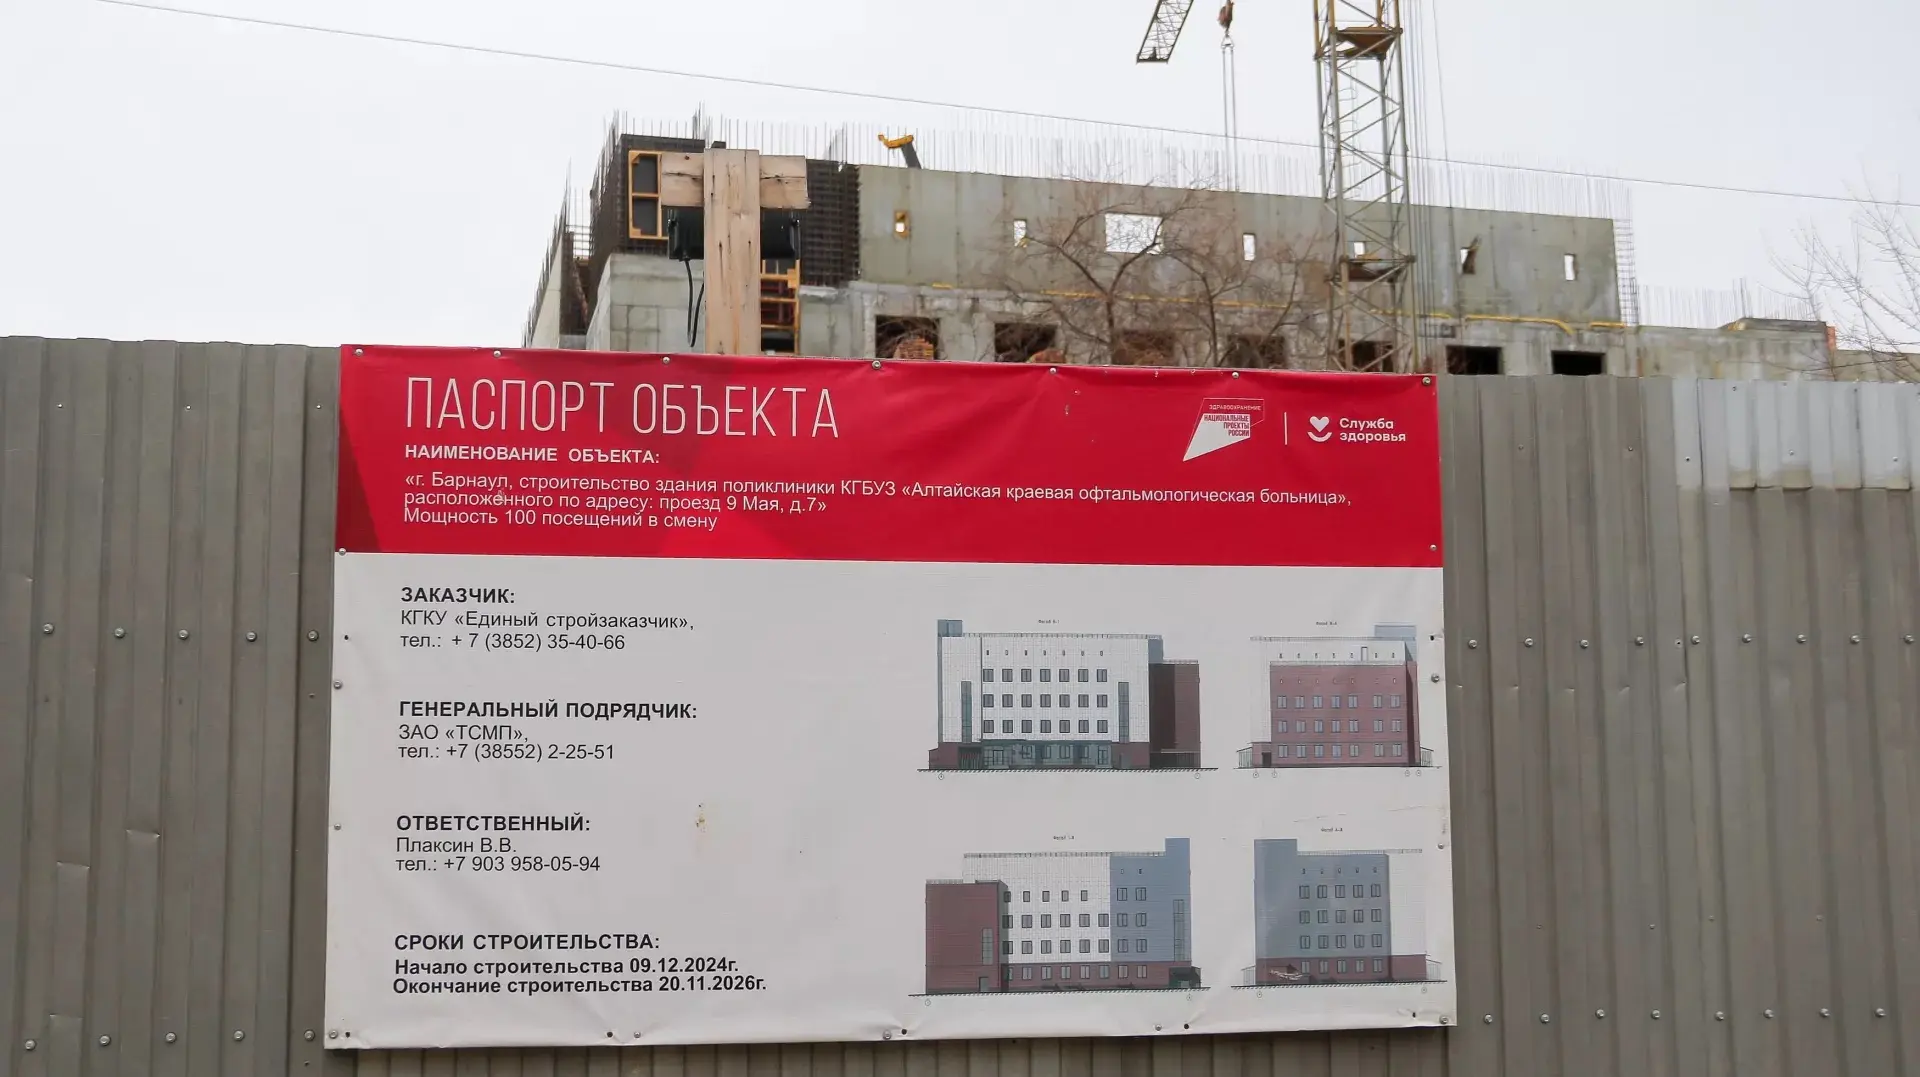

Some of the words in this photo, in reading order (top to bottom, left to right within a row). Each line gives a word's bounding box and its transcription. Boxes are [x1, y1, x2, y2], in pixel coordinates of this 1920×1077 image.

[407, 377, 614, 432] ПАСПОРТ
[633, 384, 838, 437] ОБЪЕКТА
[1204, 414, 1249, 422] НАЦИОНАЛЬНЫЕ
[1340, 418, 1393, 431] Служба
[1340, 433, 1405, 443] здоровья
[406, 445, 557, 461] НАИМЕНОВАНИЕ
[569, 449, 659, 463] ОБЪЕКТА:
[406, 475, 424, 486] «г.
[432, 472, 512, 491] Барнаул,
[520, 477, 649, 492] строительство
[656, 480, 716, 493] здания
[724, 481, 834, 494] поликлиники
[842, 480, 895, 495] КГБУЗ
[902, 482, 1000, 497] «Алтайская
[1007, 488, 1073, 501] краевая
[1079, 486, 1254, 503] офтальмологическая
[1260, 489, 1350, 506] больница»,
[404, 491, 553, 508] расположенного
[560, 496, 579, 507] по
[586, 496, 652, 512] адресу:
[660, 498, 720, 512] проезд
[727, 496, 736, 510] 9
[744, 496, 783, 513] Мая,
[790, 497, 826, 514] д.7»
[404, 507, 498, 525] Мощность
[506, 509, 535, 524] 100
[542, 511, 642, 528] посещений
[649, 516, 657, 526] в
[664, 516, 717, 531] смену
[401, 587, 514, 603] ЗАКАЗЧИК:
[402, 610, 447, 625] КГКУ
[455, 611, 537, 628] «Единый
[547, 613, 693, 630] стройзаказчик»,
[400, 636, 441, 647] тел.:
[452, 635, 461, 645] +
[469, 633, 478, 647] 7
[486, 633, 541, 652] (3852)
[548, 634, 624, 649] 35-40-66
[400, 699, 557, 717] ГЕНЕРАЛЬНЫЙ
[567, 703, 696, 721] ПОДРЯДЧИК:
[399, 724, 438, 739] ЗАО
[446, 725, 527, 742] «ТСМП»,
[398, 747, 439, 758] тел.:
[447, 744, 468, 758] +7
[475, 744, 542, 762] (38552)
[548, 744, 612, 759] 2-25-51
[397, 812, 589, 831] ОТВЕТСТВЕННЫЙ:
[397, 837, 473, 852] Плаксин
[481, 838, 516, 852] В.В.
[396, 860, 436, 871] тел.:
[444, 856, 465, 871] +7
[472, 856, 504, 871] 903
[511, 856, 600, 871] 958-05-94
[395, 935, 463, 950] СРОКИ
[474, 934, 659, 949] СТРОИТЕЛЬСТВА:
[396, 960, 467, 974] Начало
[474, 962, 623, 977] строительства
[630, 957, 738, 973] 09.12.2024г.
[393, 978, 500, 993] Окончание
[508, 980, 652, 996] строительства
[659, 975, 766, 991] 20.11.2026г.
